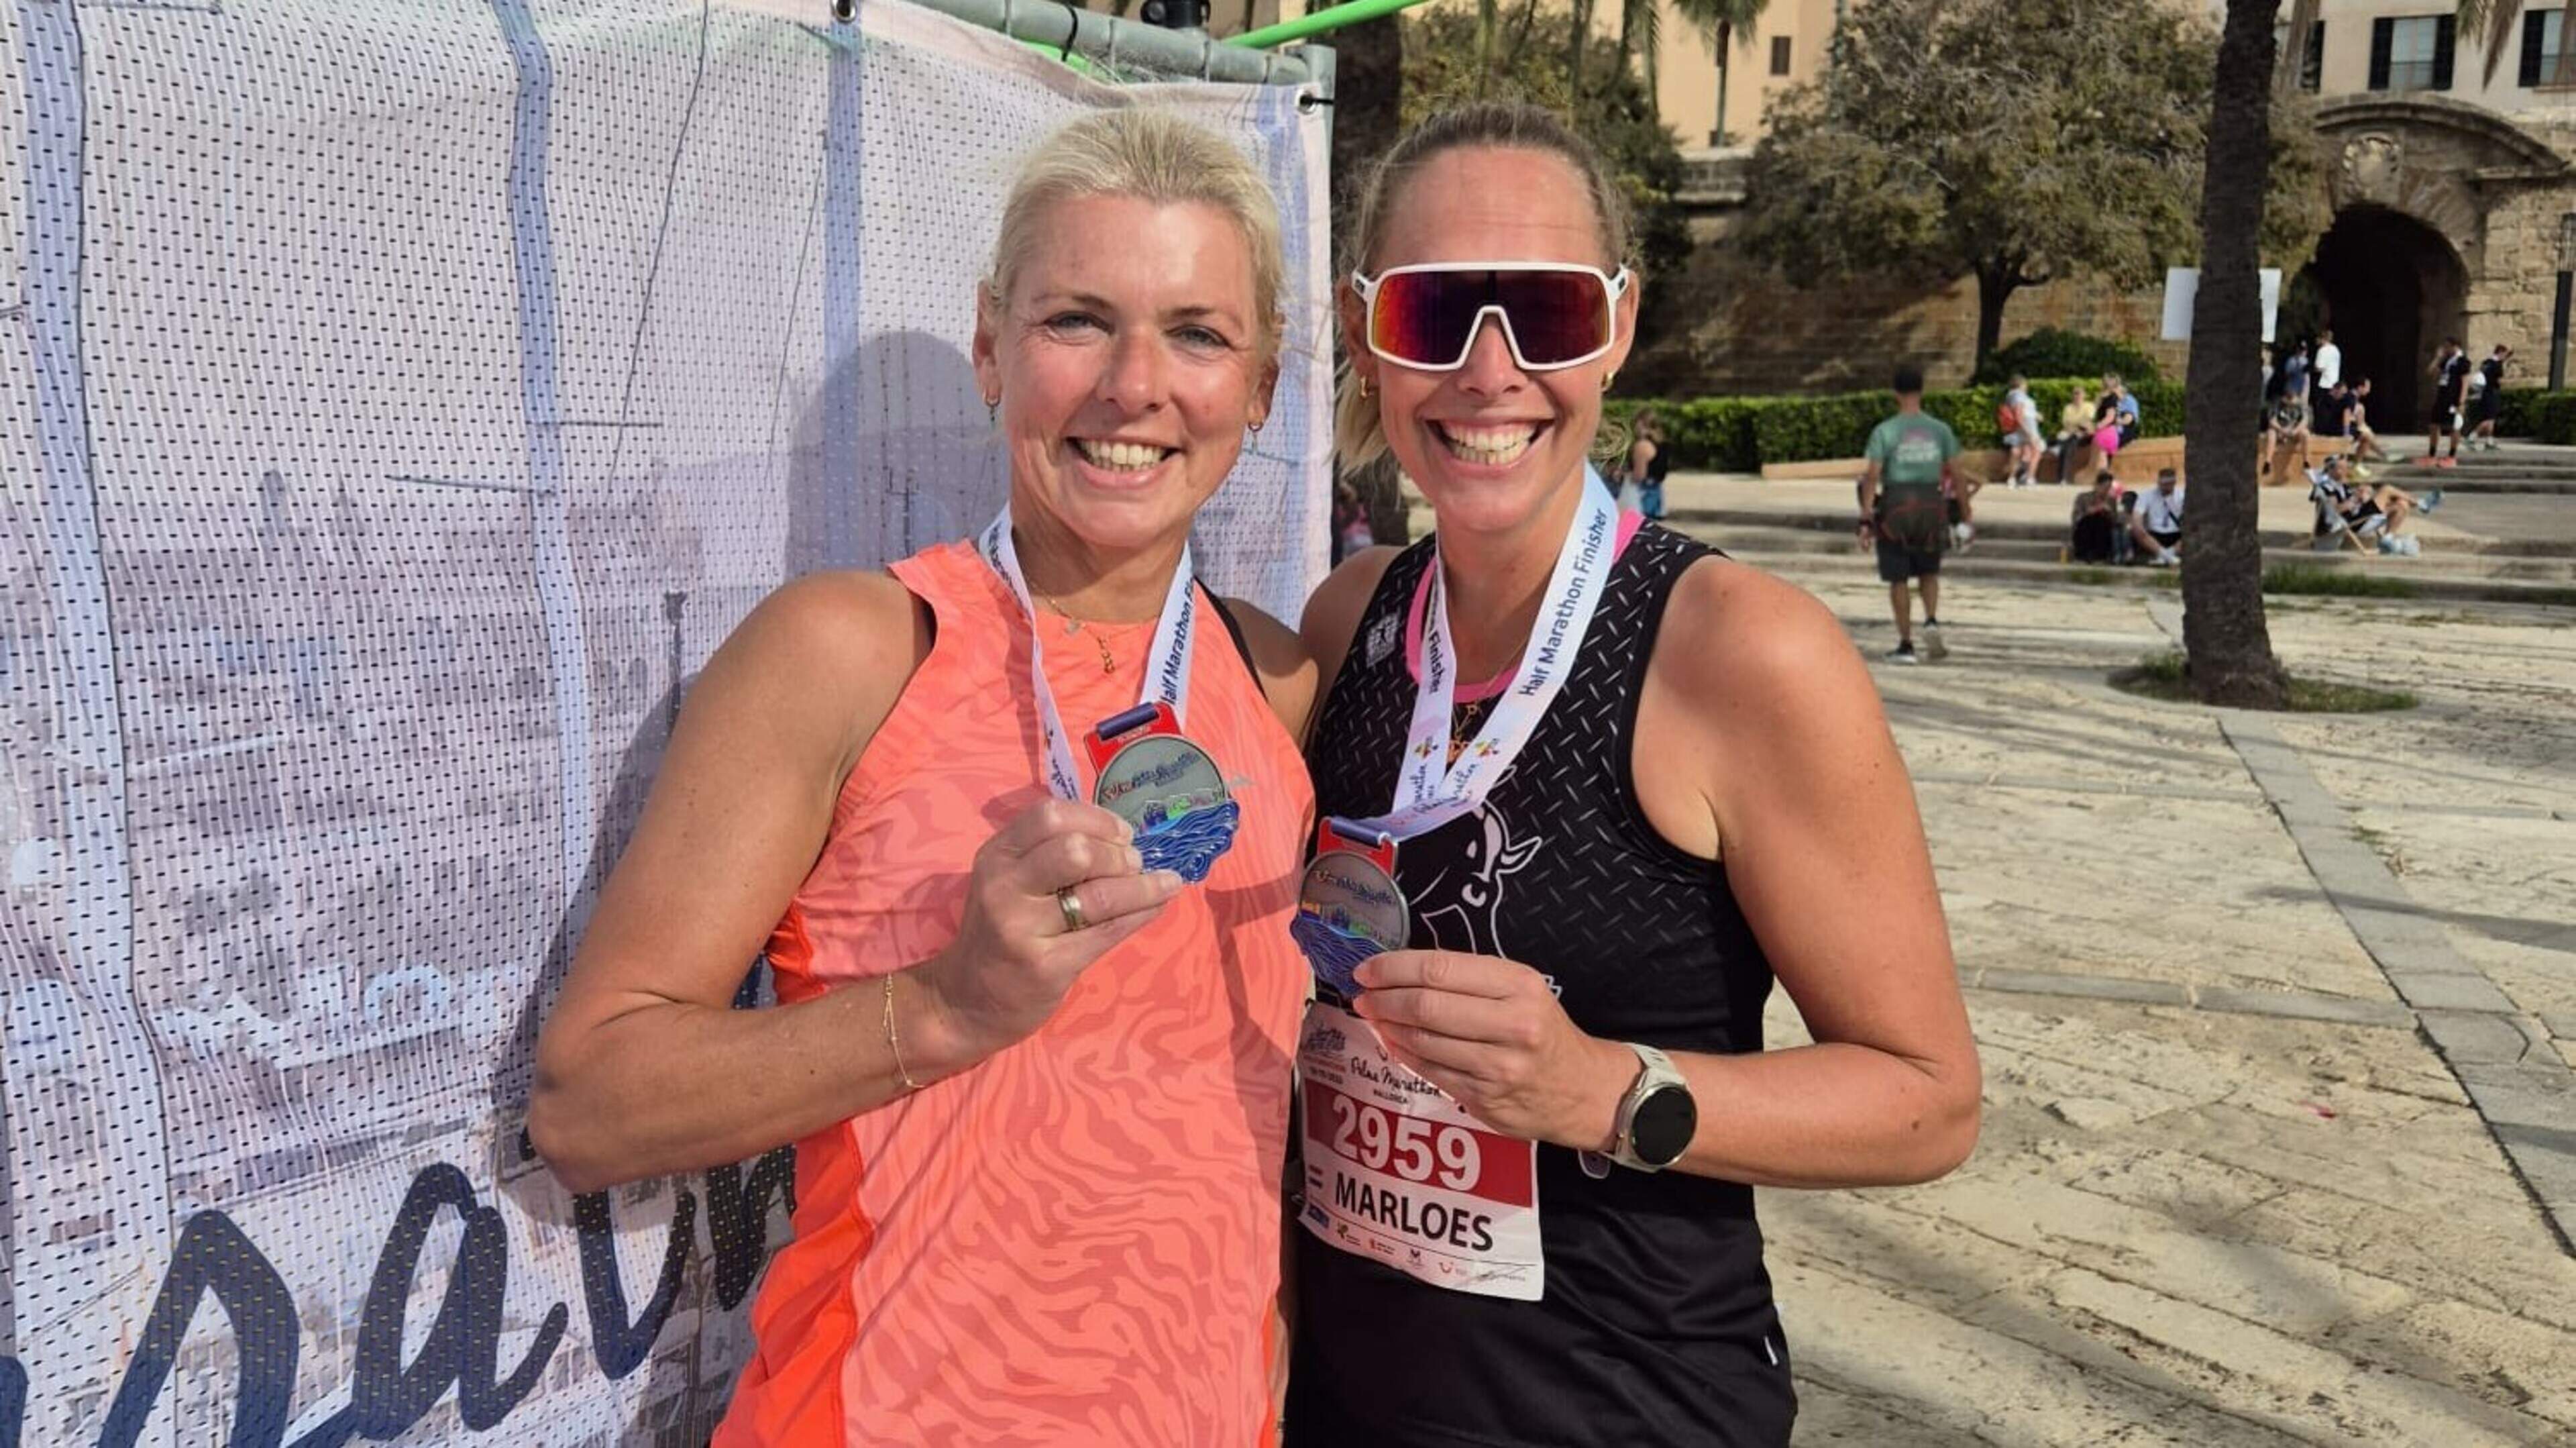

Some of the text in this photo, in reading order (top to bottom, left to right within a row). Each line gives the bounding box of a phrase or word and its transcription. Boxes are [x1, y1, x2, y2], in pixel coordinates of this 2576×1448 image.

[1163, 602, 1191, 679] Marathon
[1518, 508, 1609, 696] Half Marathon Finisher
[1332, 1094, 1481, 1192] 2959
[1334, 1172, 1494, 1252] MARLOES
